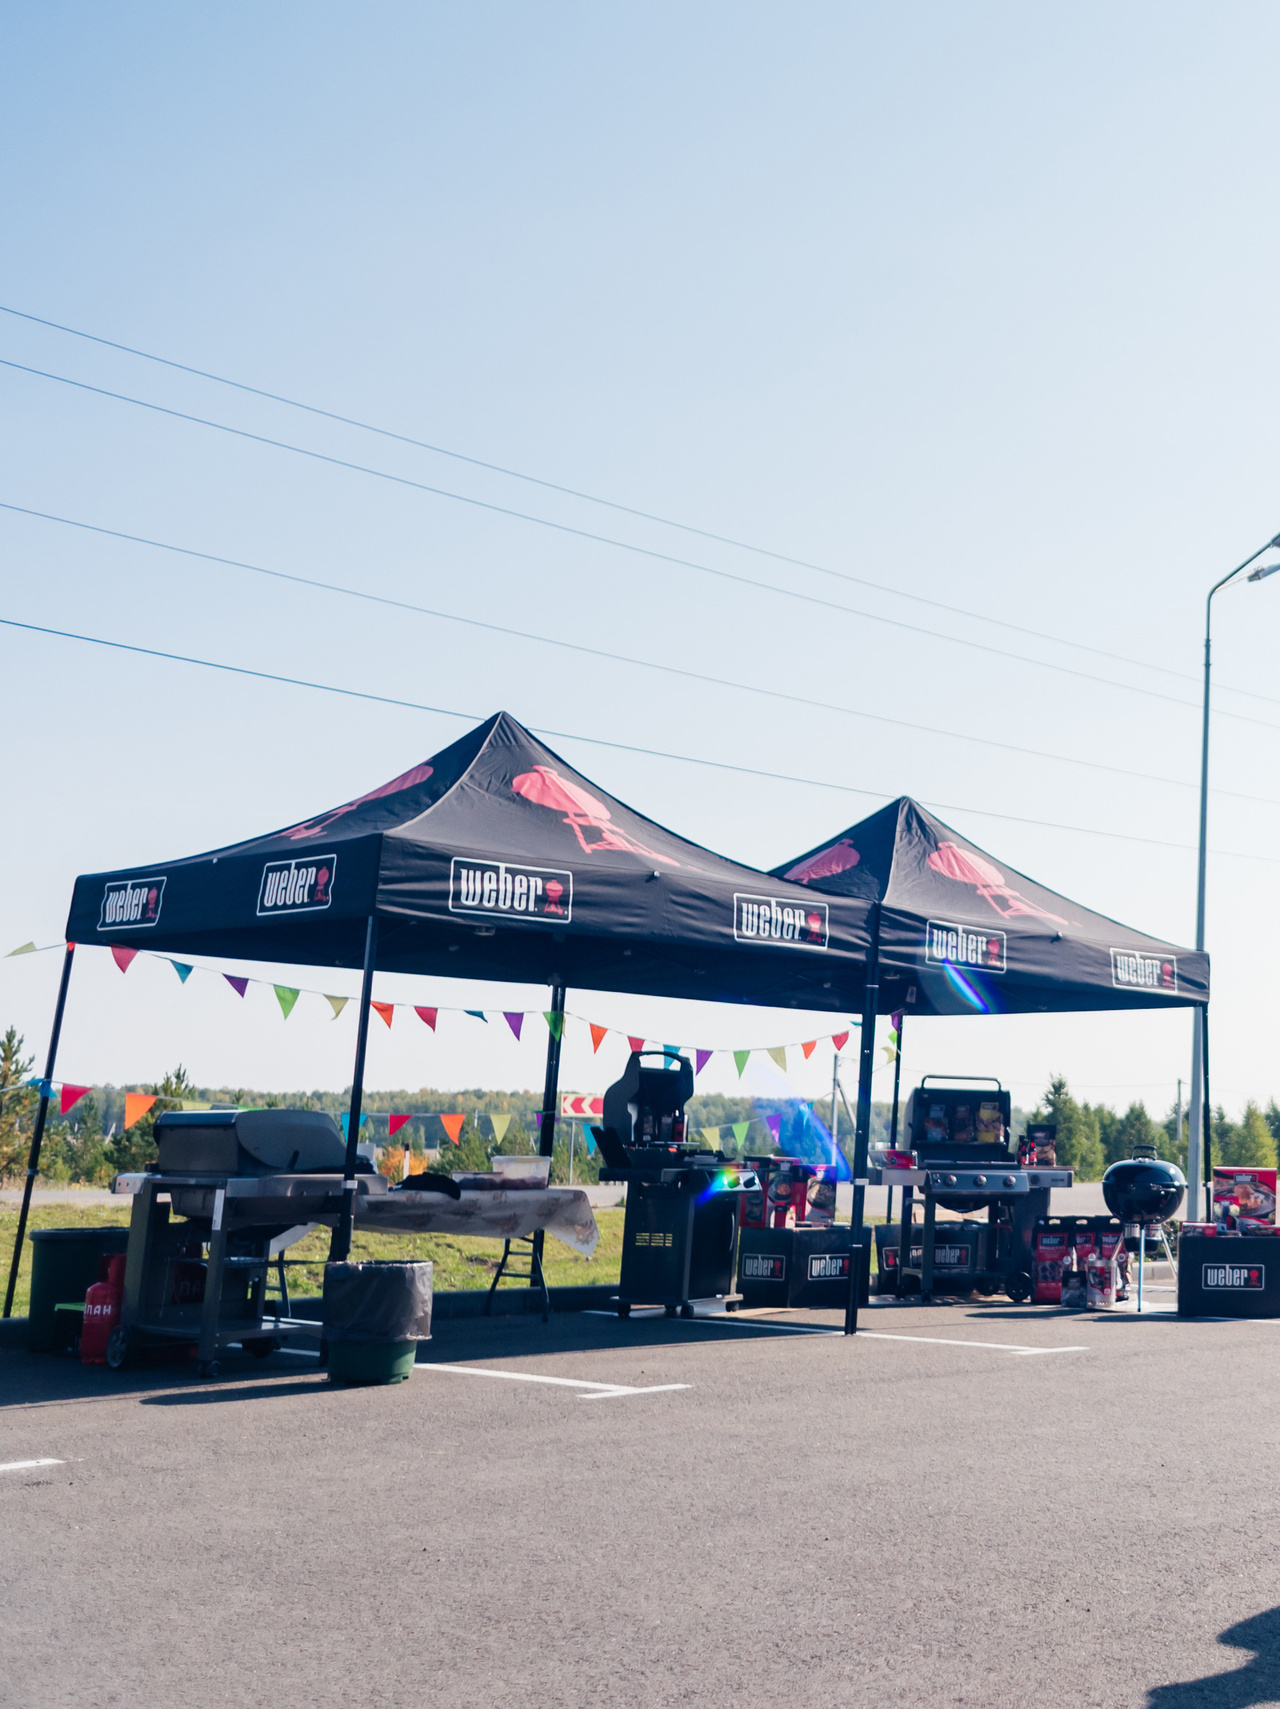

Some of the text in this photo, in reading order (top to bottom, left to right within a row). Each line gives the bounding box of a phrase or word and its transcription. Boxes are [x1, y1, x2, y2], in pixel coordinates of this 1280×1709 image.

[105, 881, 149, 923] weber
[264, 861, 317, 907] weber
[460, 864, 543, 912] weber
[741, 900, 806, 940] weber
[932, 927, 987, 965] weber
[1116, 952, 1161, 986] weber
[745, 1255, 774, 1276] weber
[811, 1255, 842, 1277] weber
[935, 1245, 960, 1264] weber
[1207, 1264, 1248, 1286] weber
